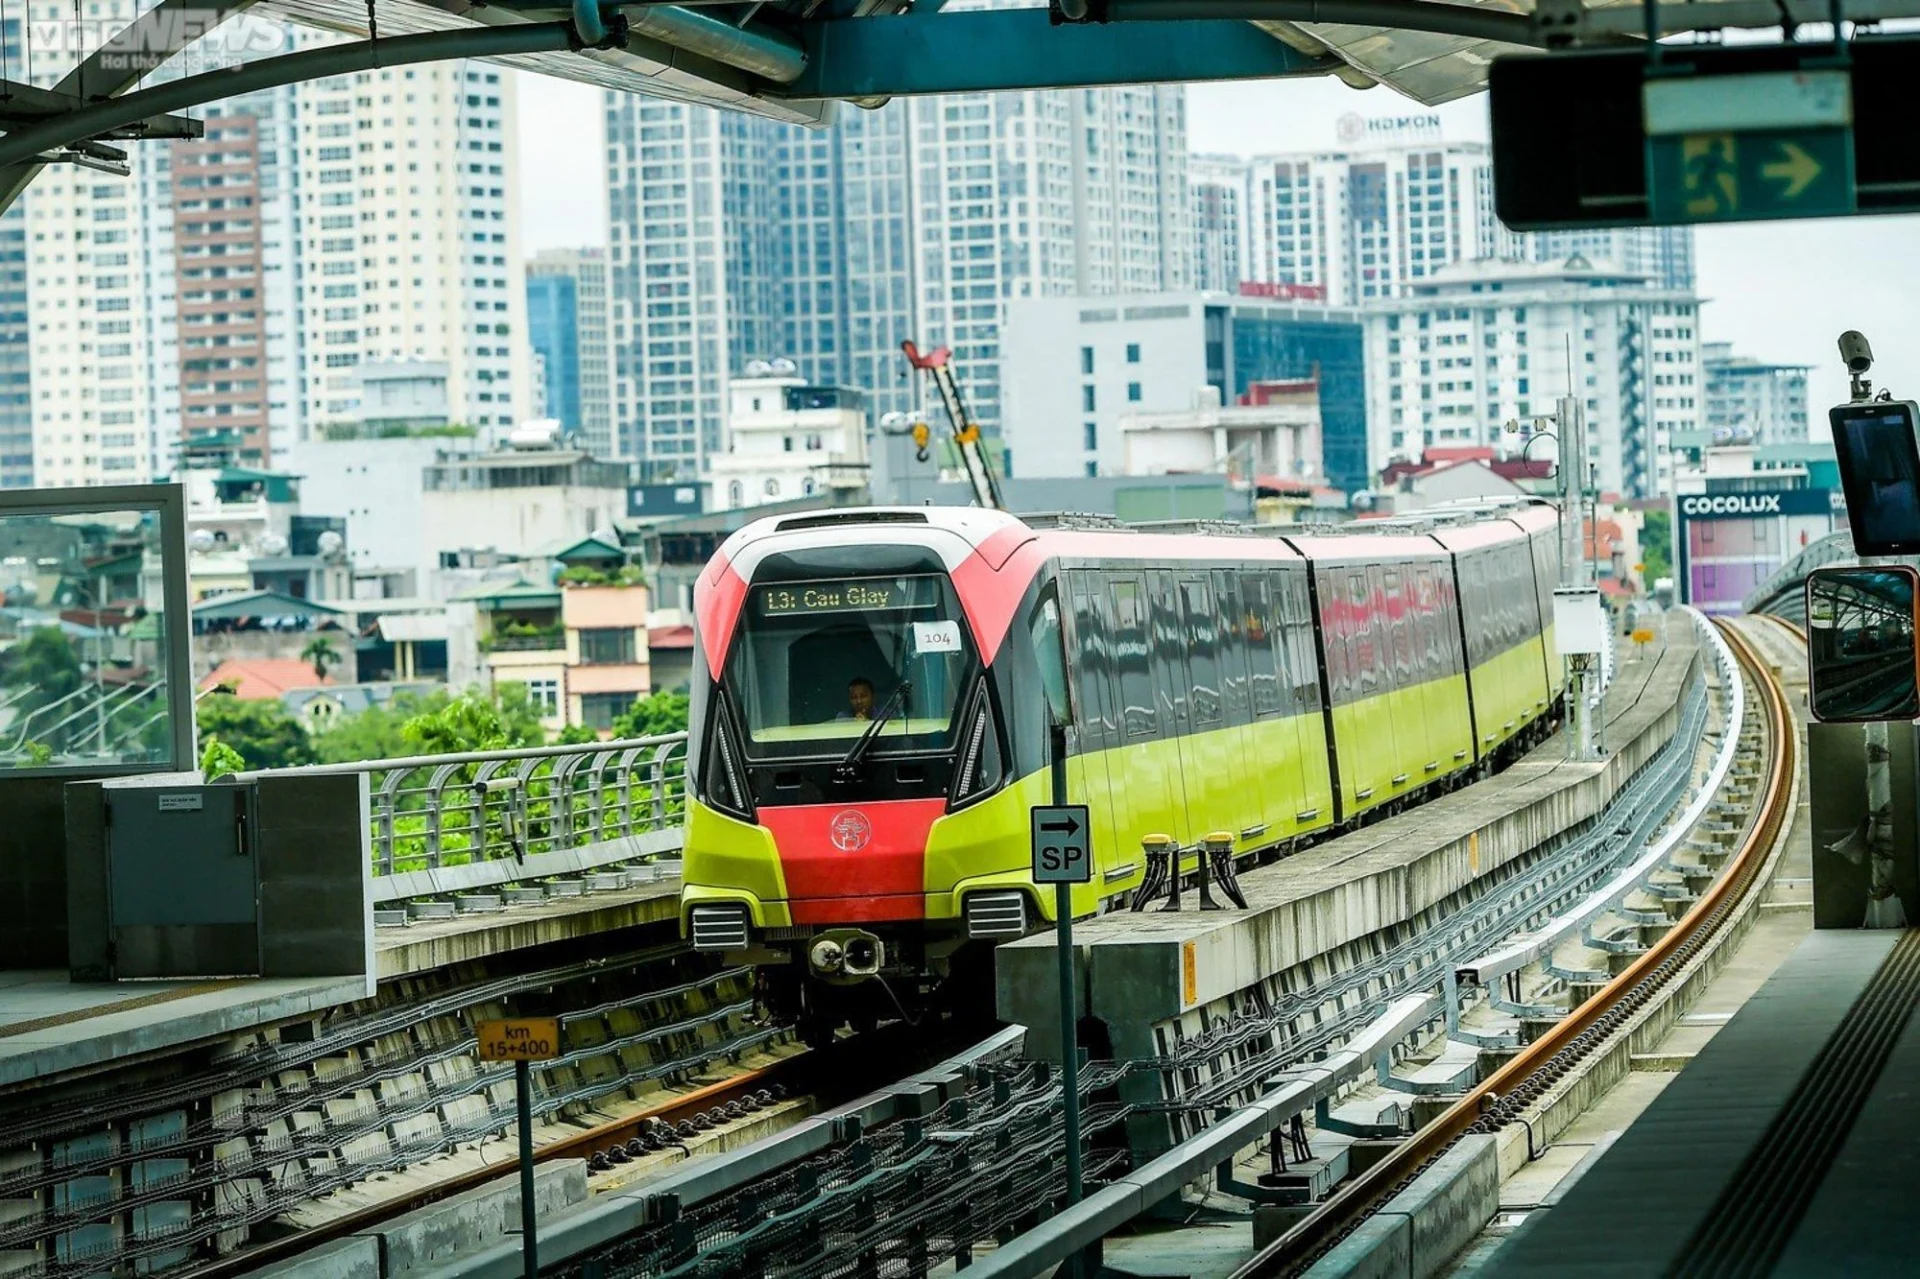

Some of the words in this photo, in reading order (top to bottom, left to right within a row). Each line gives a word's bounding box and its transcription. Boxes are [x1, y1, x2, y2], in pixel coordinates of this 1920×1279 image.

[1683, 494, 1781, 515] COCOLUX
[768, 591, 796, 610] L3:
[804, 590, 840, 607] Cau
[924, 632, 952, 646] 104
[1041, 846, 1083, 871] SP
[504, 1025, 530, 1039] km
[487, 1040, 550, 1057] 15+400
